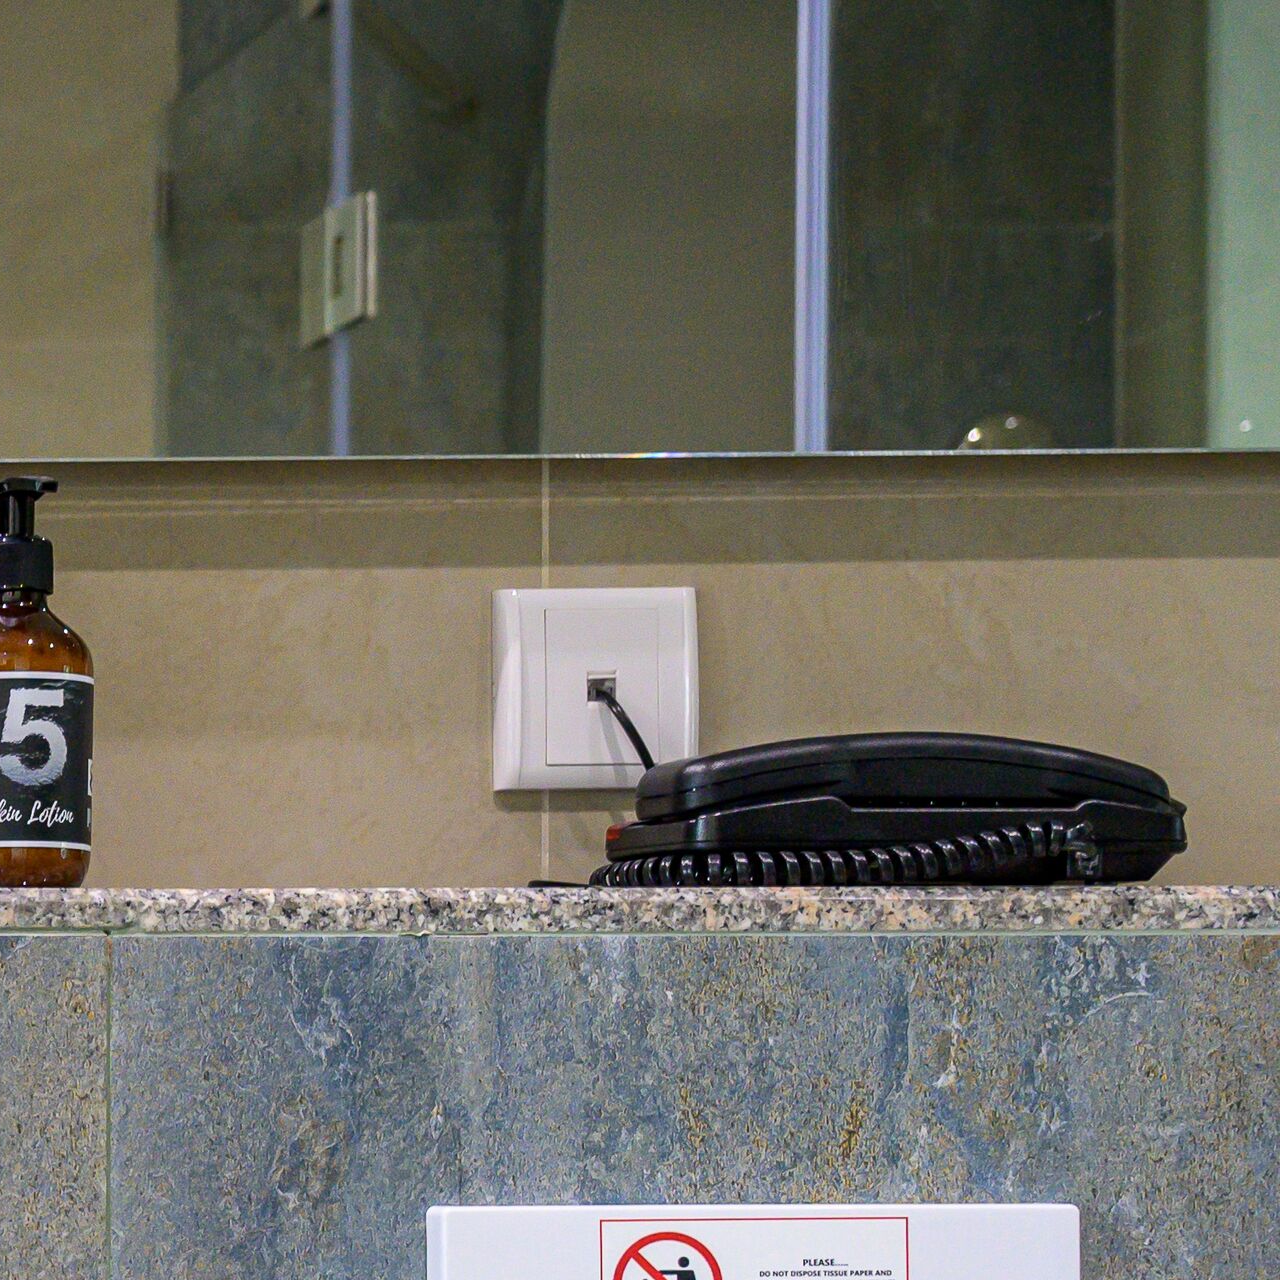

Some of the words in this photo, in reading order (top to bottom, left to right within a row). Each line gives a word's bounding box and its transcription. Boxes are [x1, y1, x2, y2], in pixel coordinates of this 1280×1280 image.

[26, 799, 75, 828] Lotion
[759, 1270, 771, 1278] DO
[772, 1270, 789, 1278] NOT
[790, 1270, 821, 1278] DISPOSE
[849, 1269, 874, 1277] PAPER
[875, 1269, 893, 1277] AND
